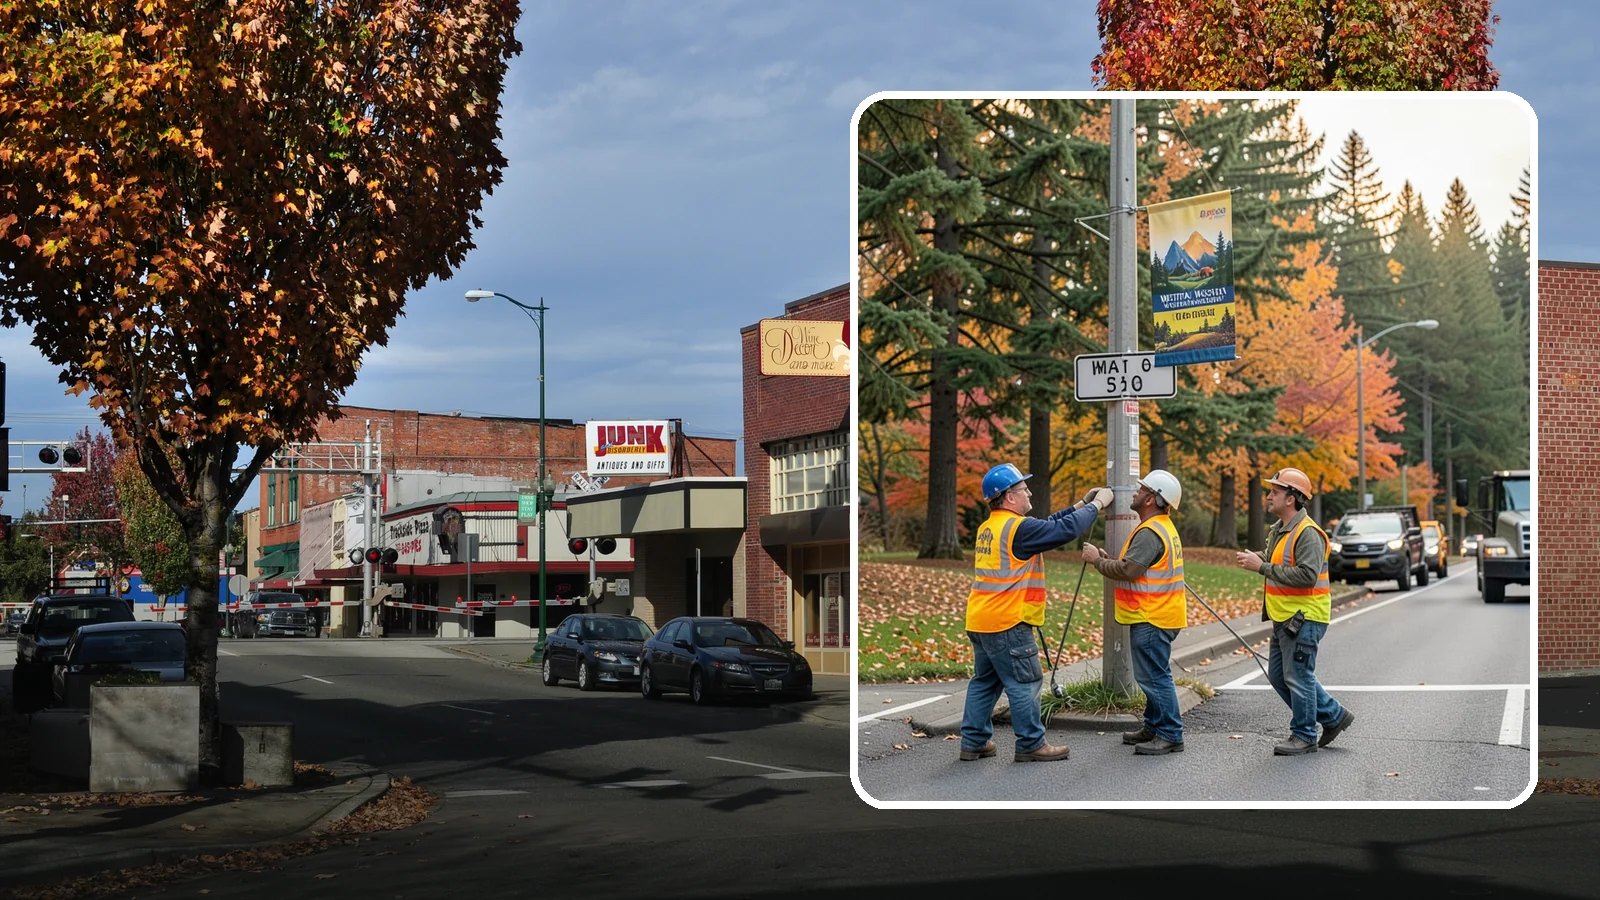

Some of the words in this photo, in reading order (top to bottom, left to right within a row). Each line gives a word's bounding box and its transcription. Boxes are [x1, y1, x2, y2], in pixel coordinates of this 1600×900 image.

[595, 425, 665, 457] JUNK
[597, 461, 628, 470] ANTIQUES
[631, 461, 643, 469] AND
[647, 461, 665, 469] GIFTS
[390, 521, 413, 540] Trackside
[414, 519, 429, 535] Pizza
